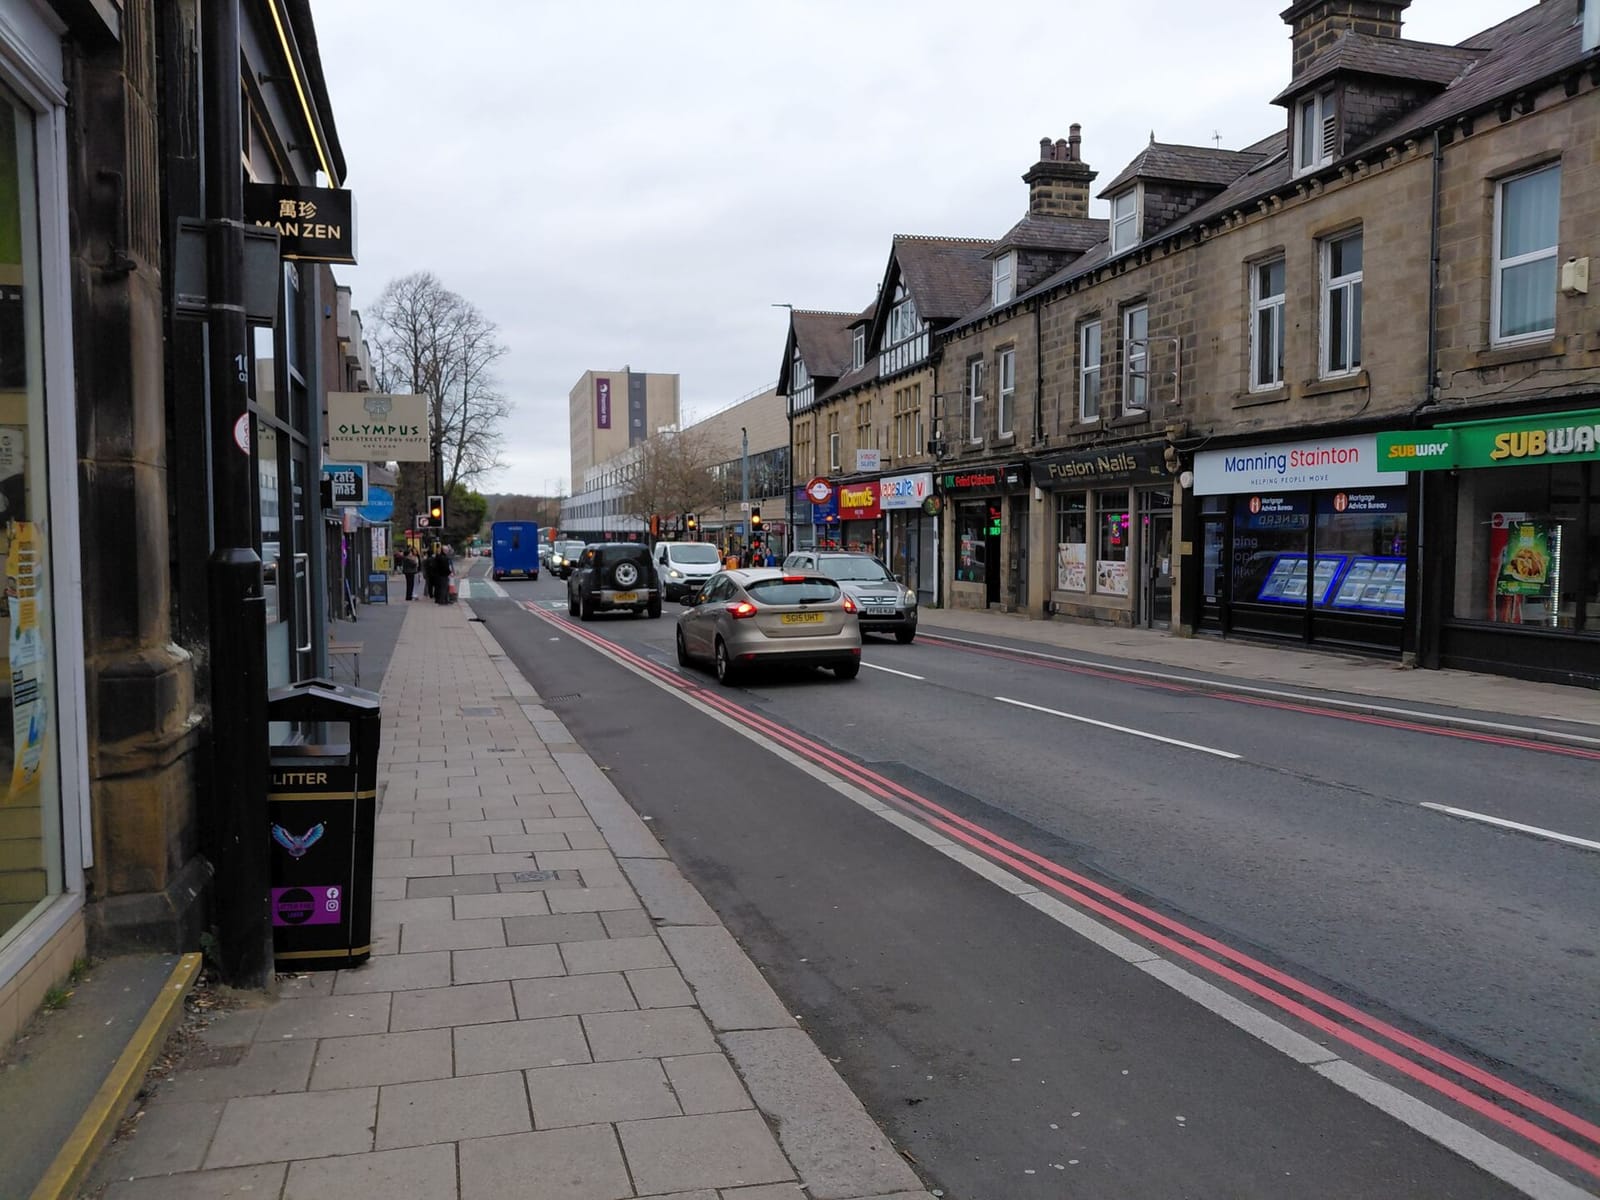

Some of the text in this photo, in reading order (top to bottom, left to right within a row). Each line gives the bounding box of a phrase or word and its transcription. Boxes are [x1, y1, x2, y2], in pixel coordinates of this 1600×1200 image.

[279, 199, 317, 219] 萬珍
[302, 223, 341, 239] ZEN
[338, 424, 419, 435] OLYMPUS
[1489, 424, 1600, 461] SUBWA
[1388, 443, 1449, 459] SUBWAY
[1048, 460, 1095, 478] Fusion
[1098, 453, 1137, 472] Nails
[1225, 447, 1359, 474] Manning Stainton
[945, 475, 956, 488] UK
[1251, 474, 1329, 486] HELPING PEOPLE MOVE
[1262, 497, 1284, 505] Mortgage
[1349, 494, 1375, 502] Mortgage
[1277, 503, 1293, 511] Bureau
[1348, 501, 1387, 510] Advice Bureau
[273, 773, 328, 785] LITTER
